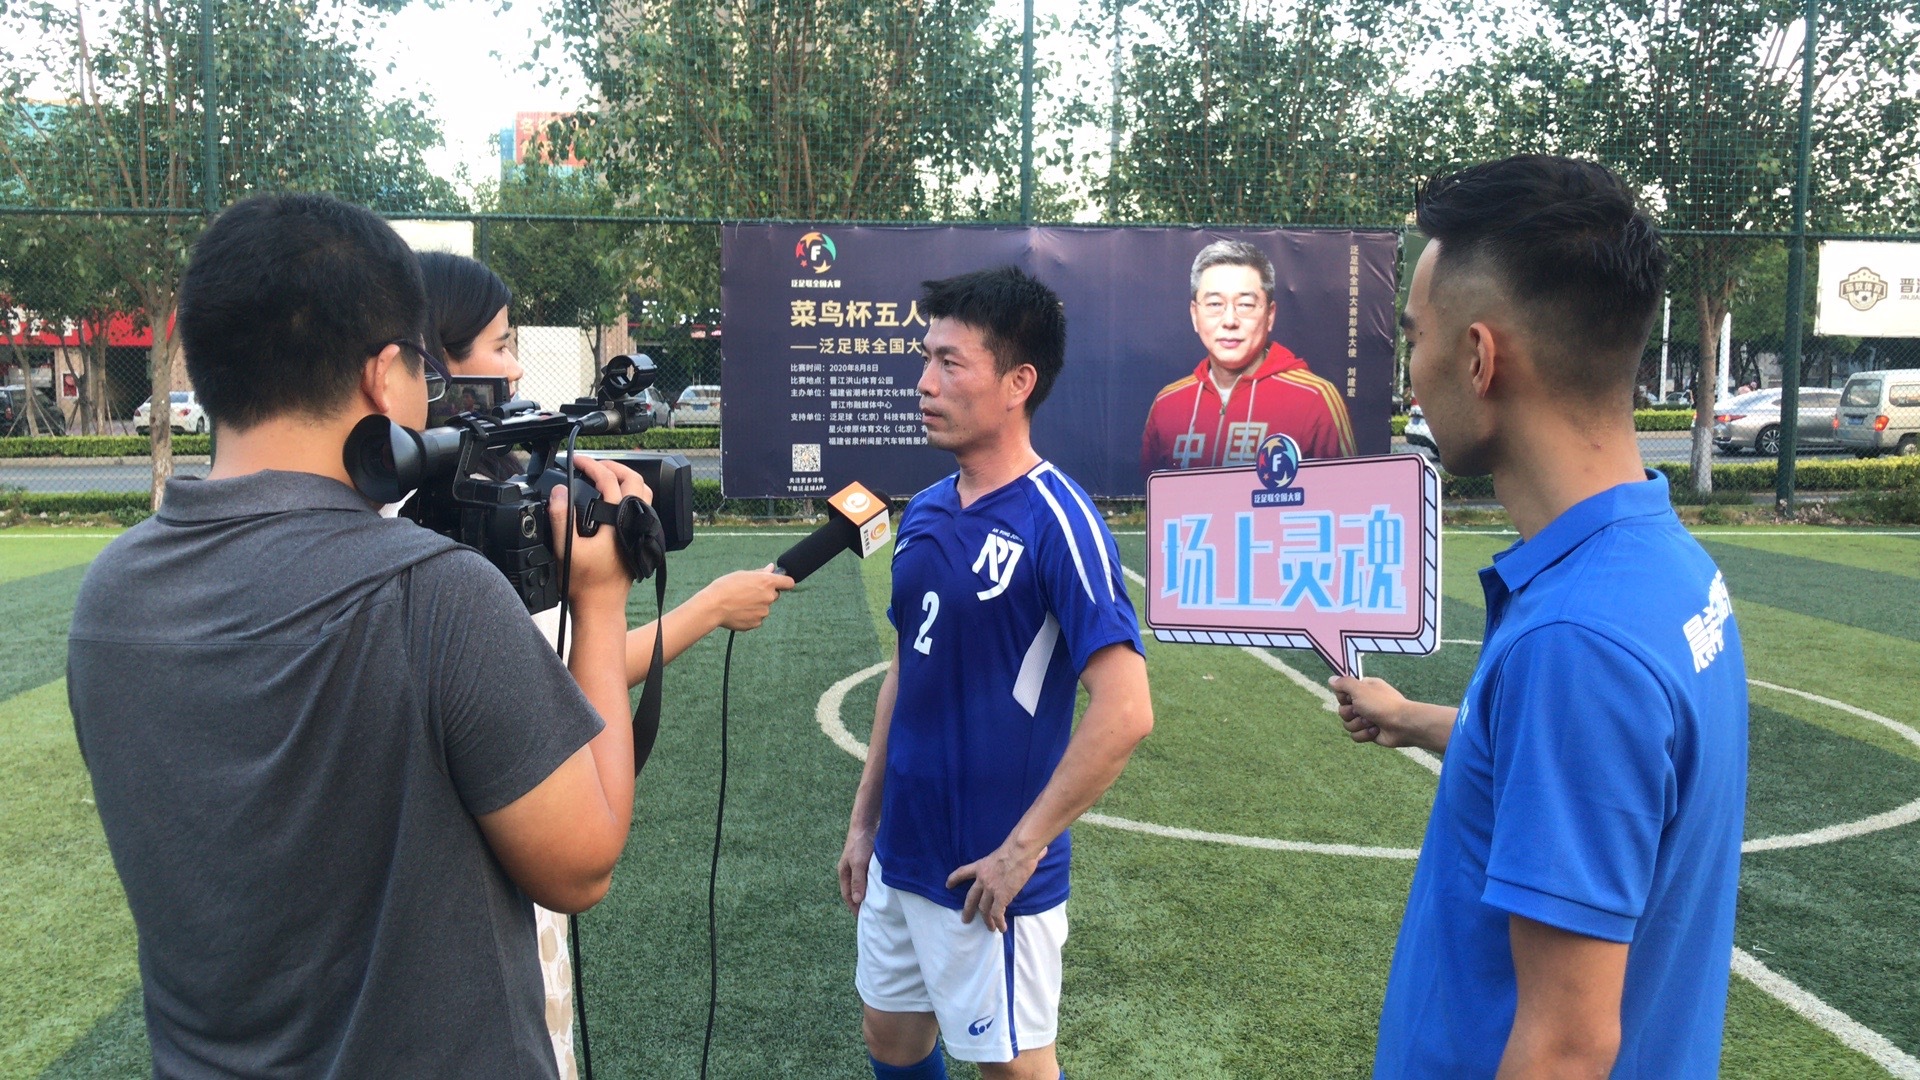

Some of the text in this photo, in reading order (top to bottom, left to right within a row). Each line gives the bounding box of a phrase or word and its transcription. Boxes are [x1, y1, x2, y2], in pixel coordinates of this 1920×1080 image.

[810, 245, 822, 261] F
[791, 279, 841, 288] 泛足联全国大赛
[790, 300, 932, 328] 菜鸟杯五人
[790, 412, 925, 421] 支持单位：泛足球（北京）科技有限公
[1160, 504, 1407, 614] 场上灵魂
[913, 591, 940, 655] 2
